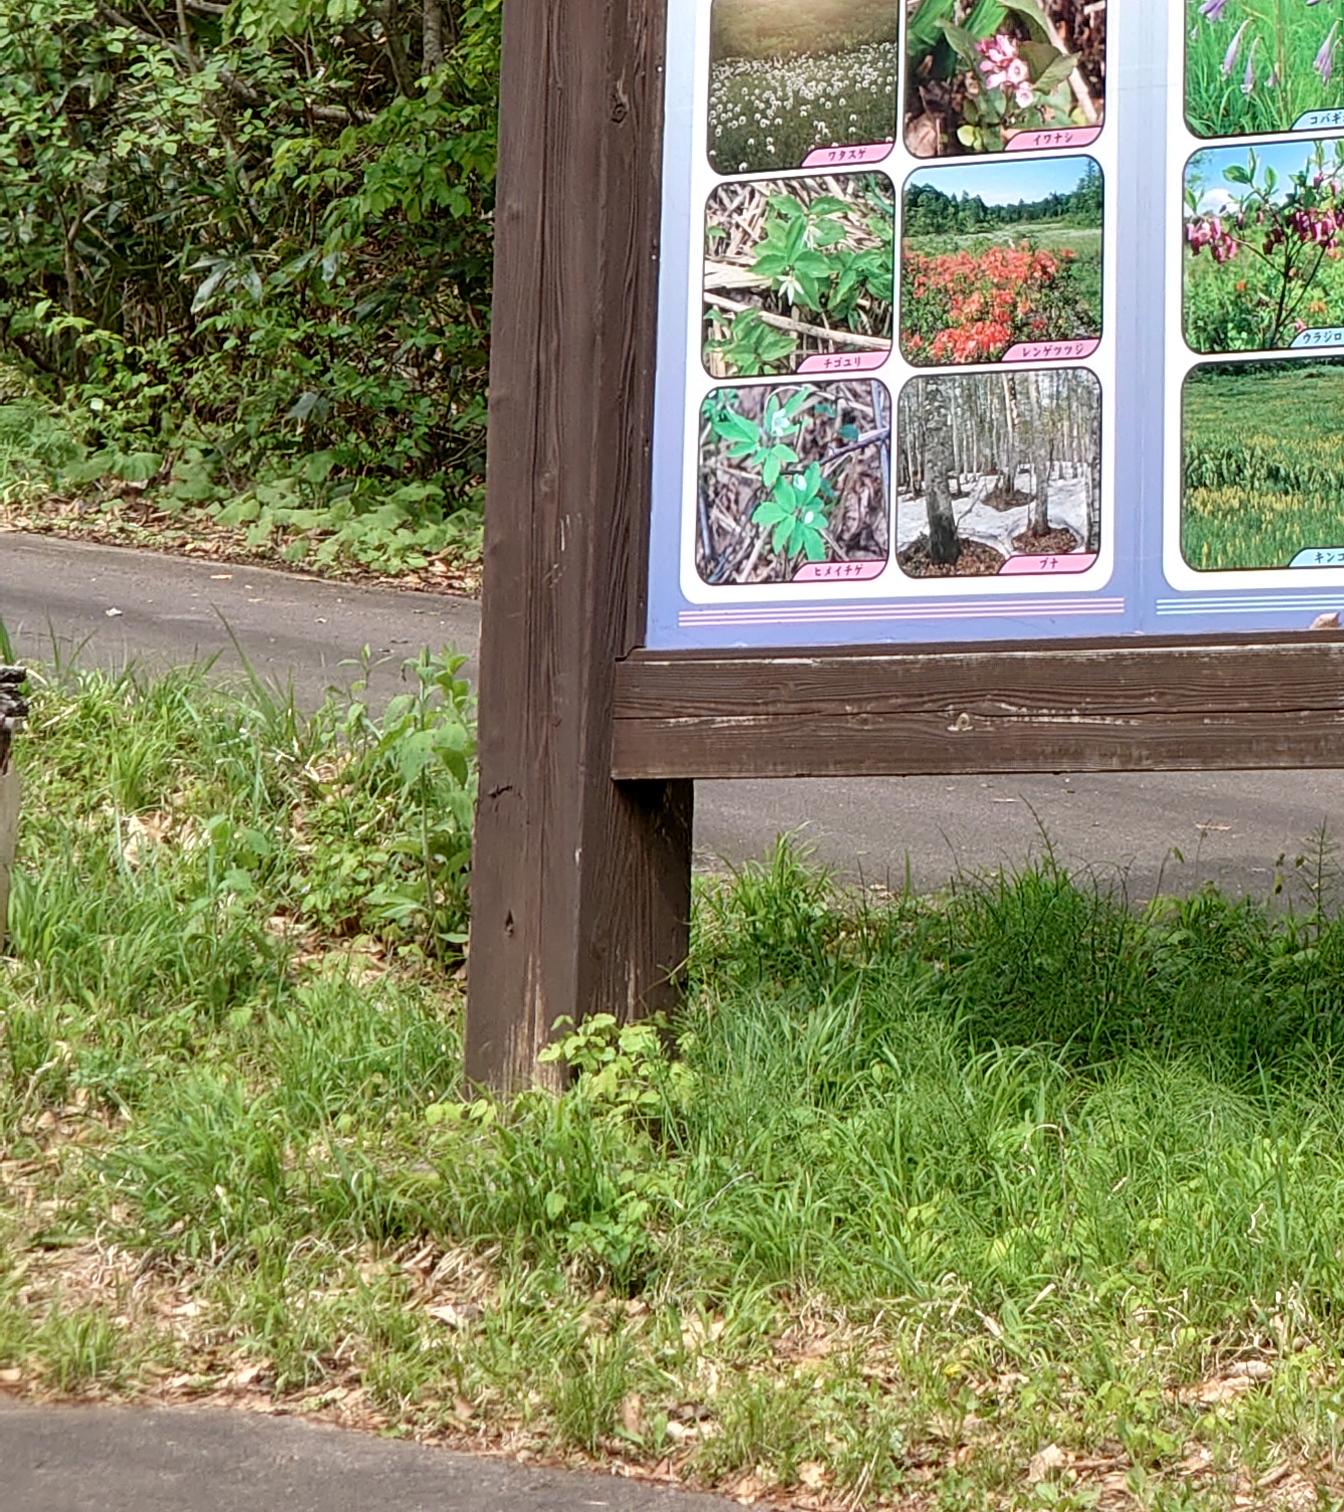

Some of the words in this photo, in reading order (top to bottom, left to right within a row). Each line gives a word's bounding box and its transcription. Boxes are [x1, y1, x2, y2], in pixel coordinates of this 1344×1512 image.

[1033, 133, 1073, 145] イワナシ
[828, 148, 867, 160] ワタスゲ
[1022, 344, 1084, 357] レンゲツツジ
[823, 358, 861, 368] チゴユリ
[1039, 558, 1058, 569] ブナ
[815, 564, 864, 576] ヒメイチゲ
